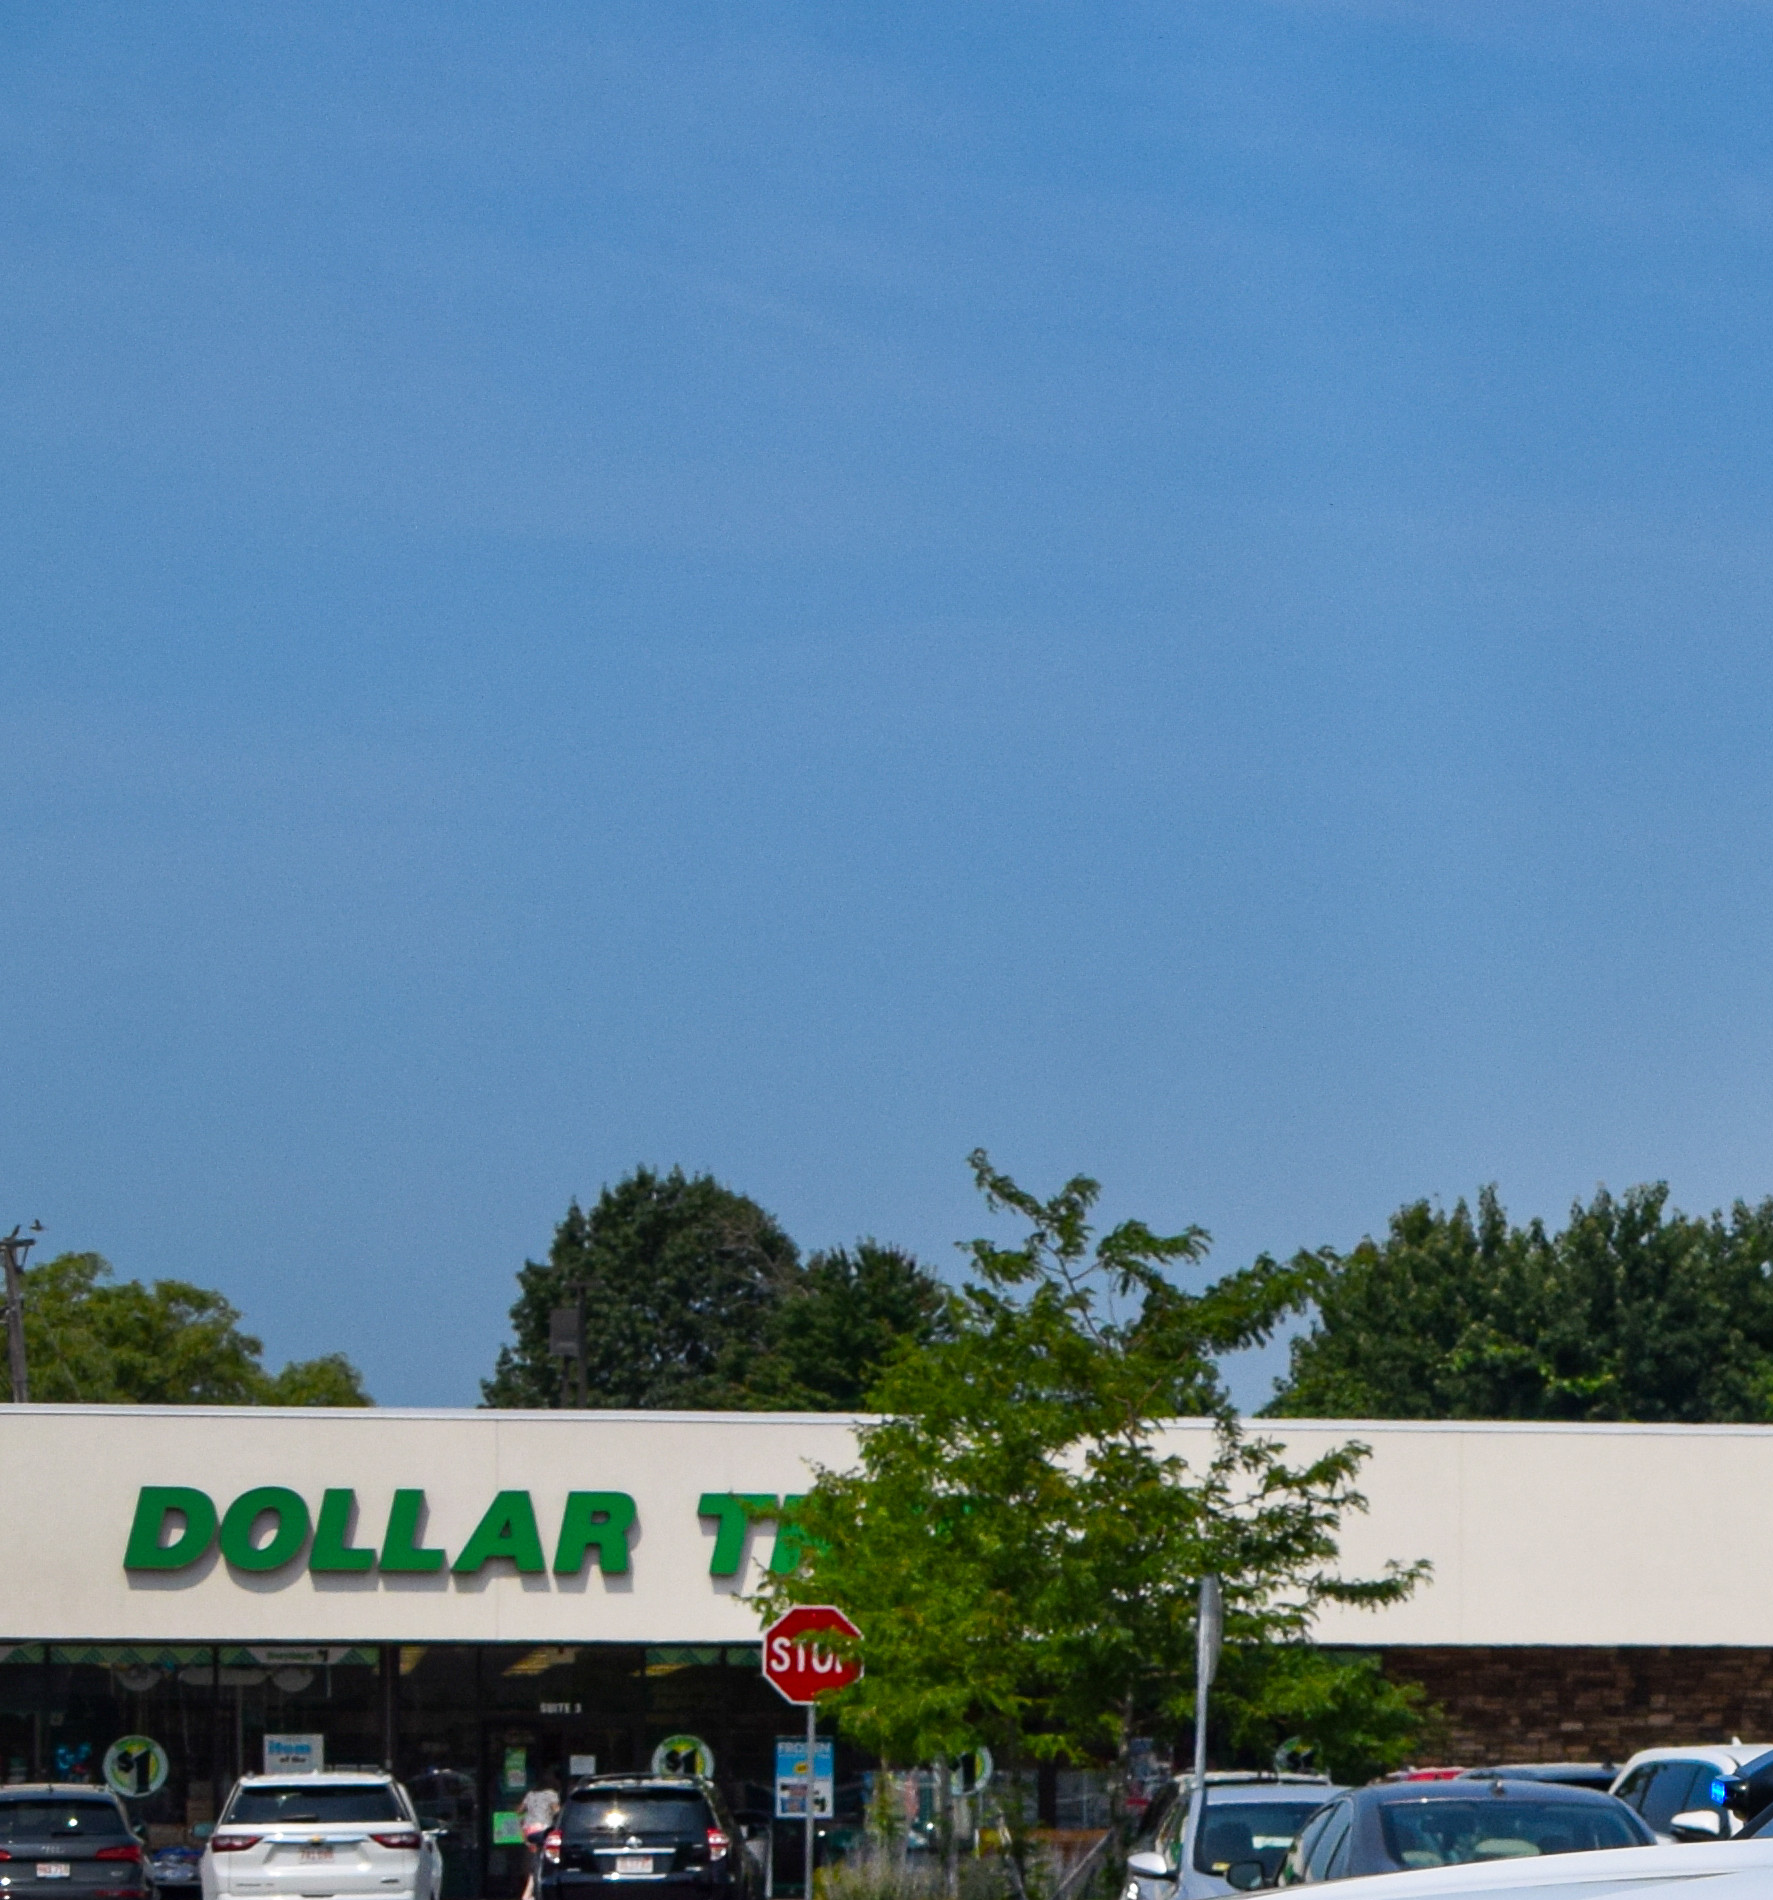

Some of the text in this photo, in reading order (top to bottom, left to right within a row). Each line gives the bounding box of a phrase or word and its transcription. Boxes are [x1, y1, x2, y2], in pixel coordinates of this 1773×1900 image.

[123, 1486, 637, 1574] DOLLAR
[770, 1636, 843, 1673] STO
[540, 1702, 570, 1714] SUITE
